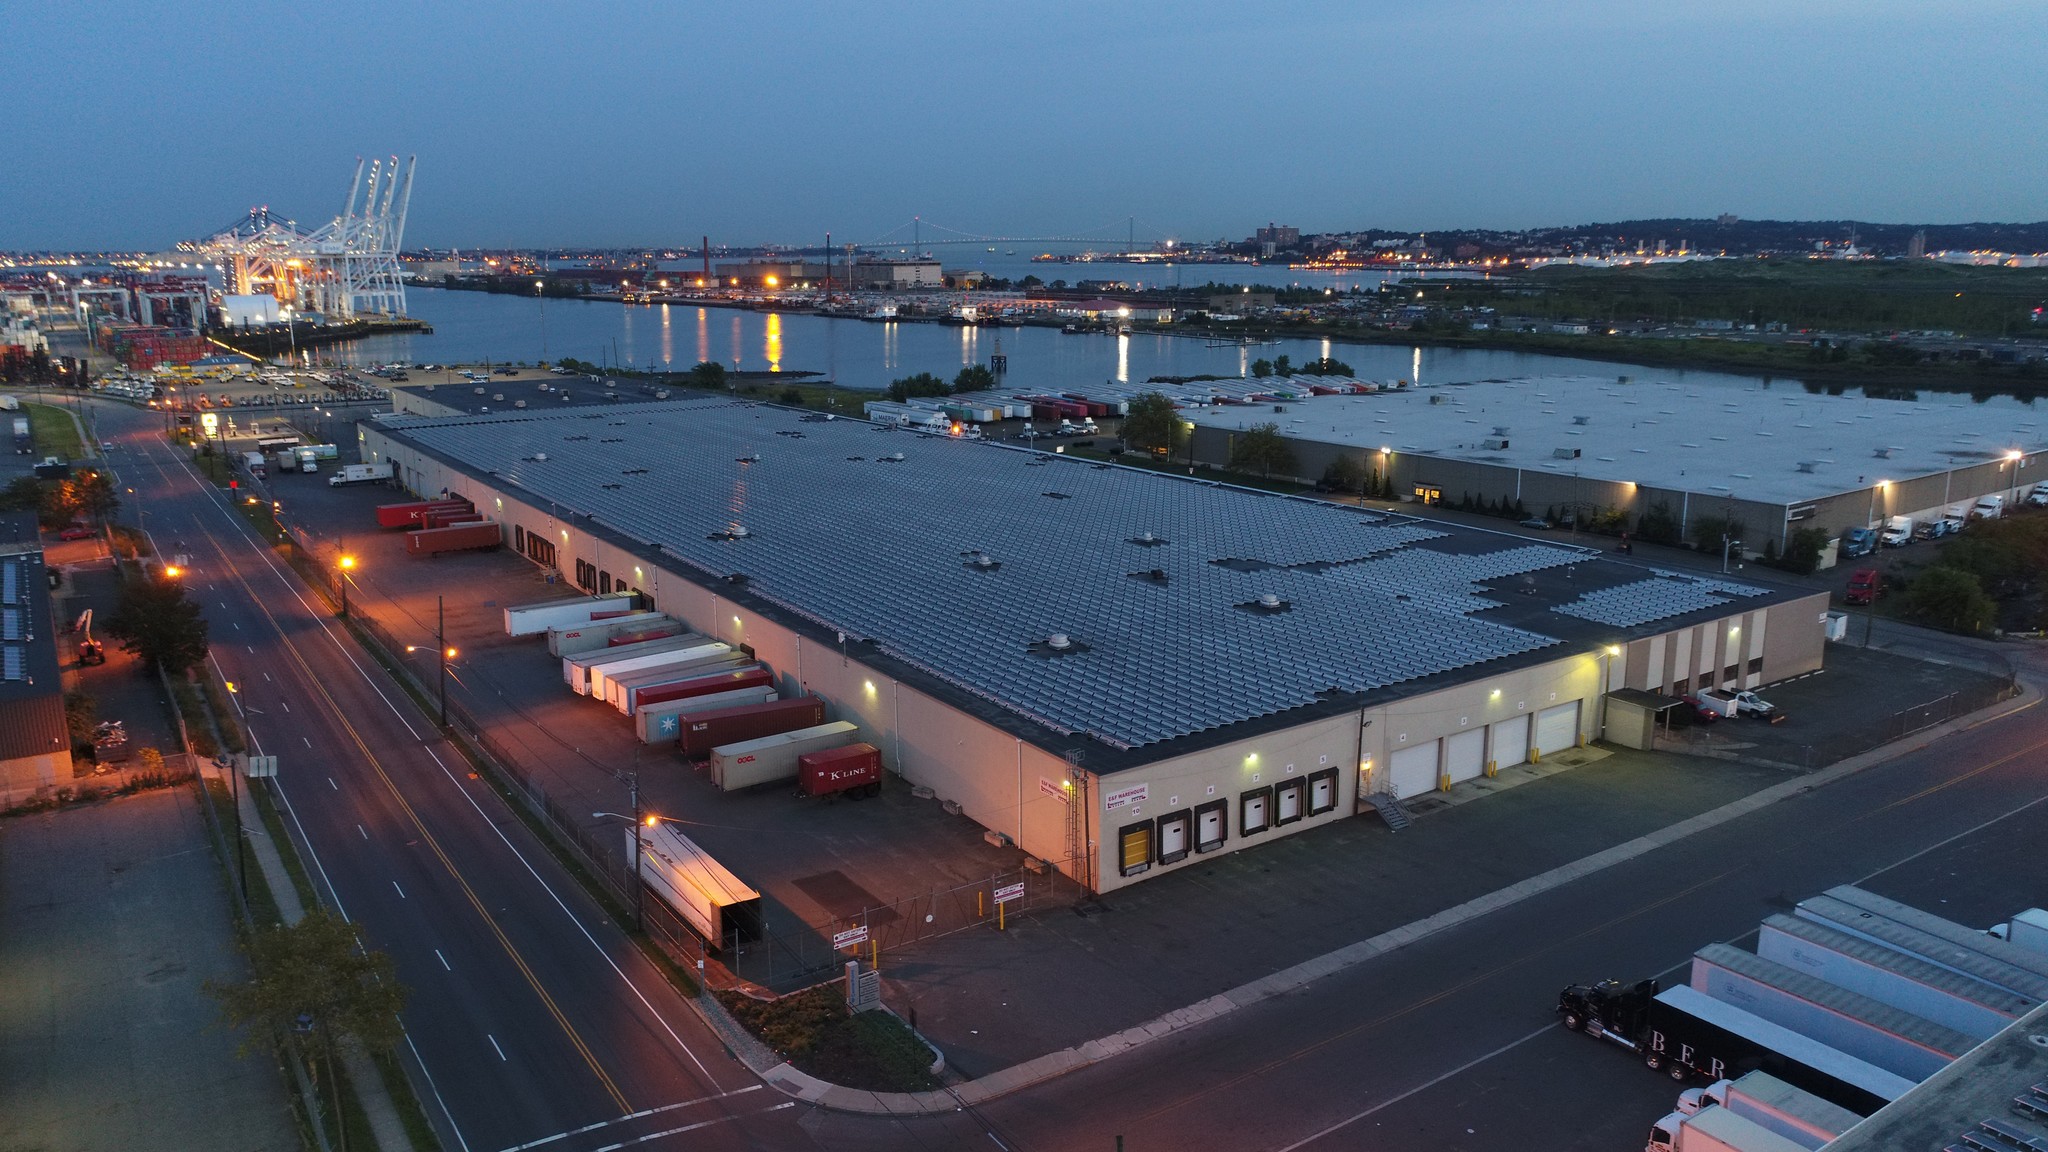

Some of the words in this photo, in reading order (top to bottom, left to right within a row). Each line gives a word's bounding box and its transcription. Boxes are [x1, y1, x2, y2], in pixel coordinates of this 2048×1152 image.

[738, 756, 756, 764] OOCL
[843, 768, 866, 778] LINE
[1118, 787, 1146, 798] WAREHOUSE
